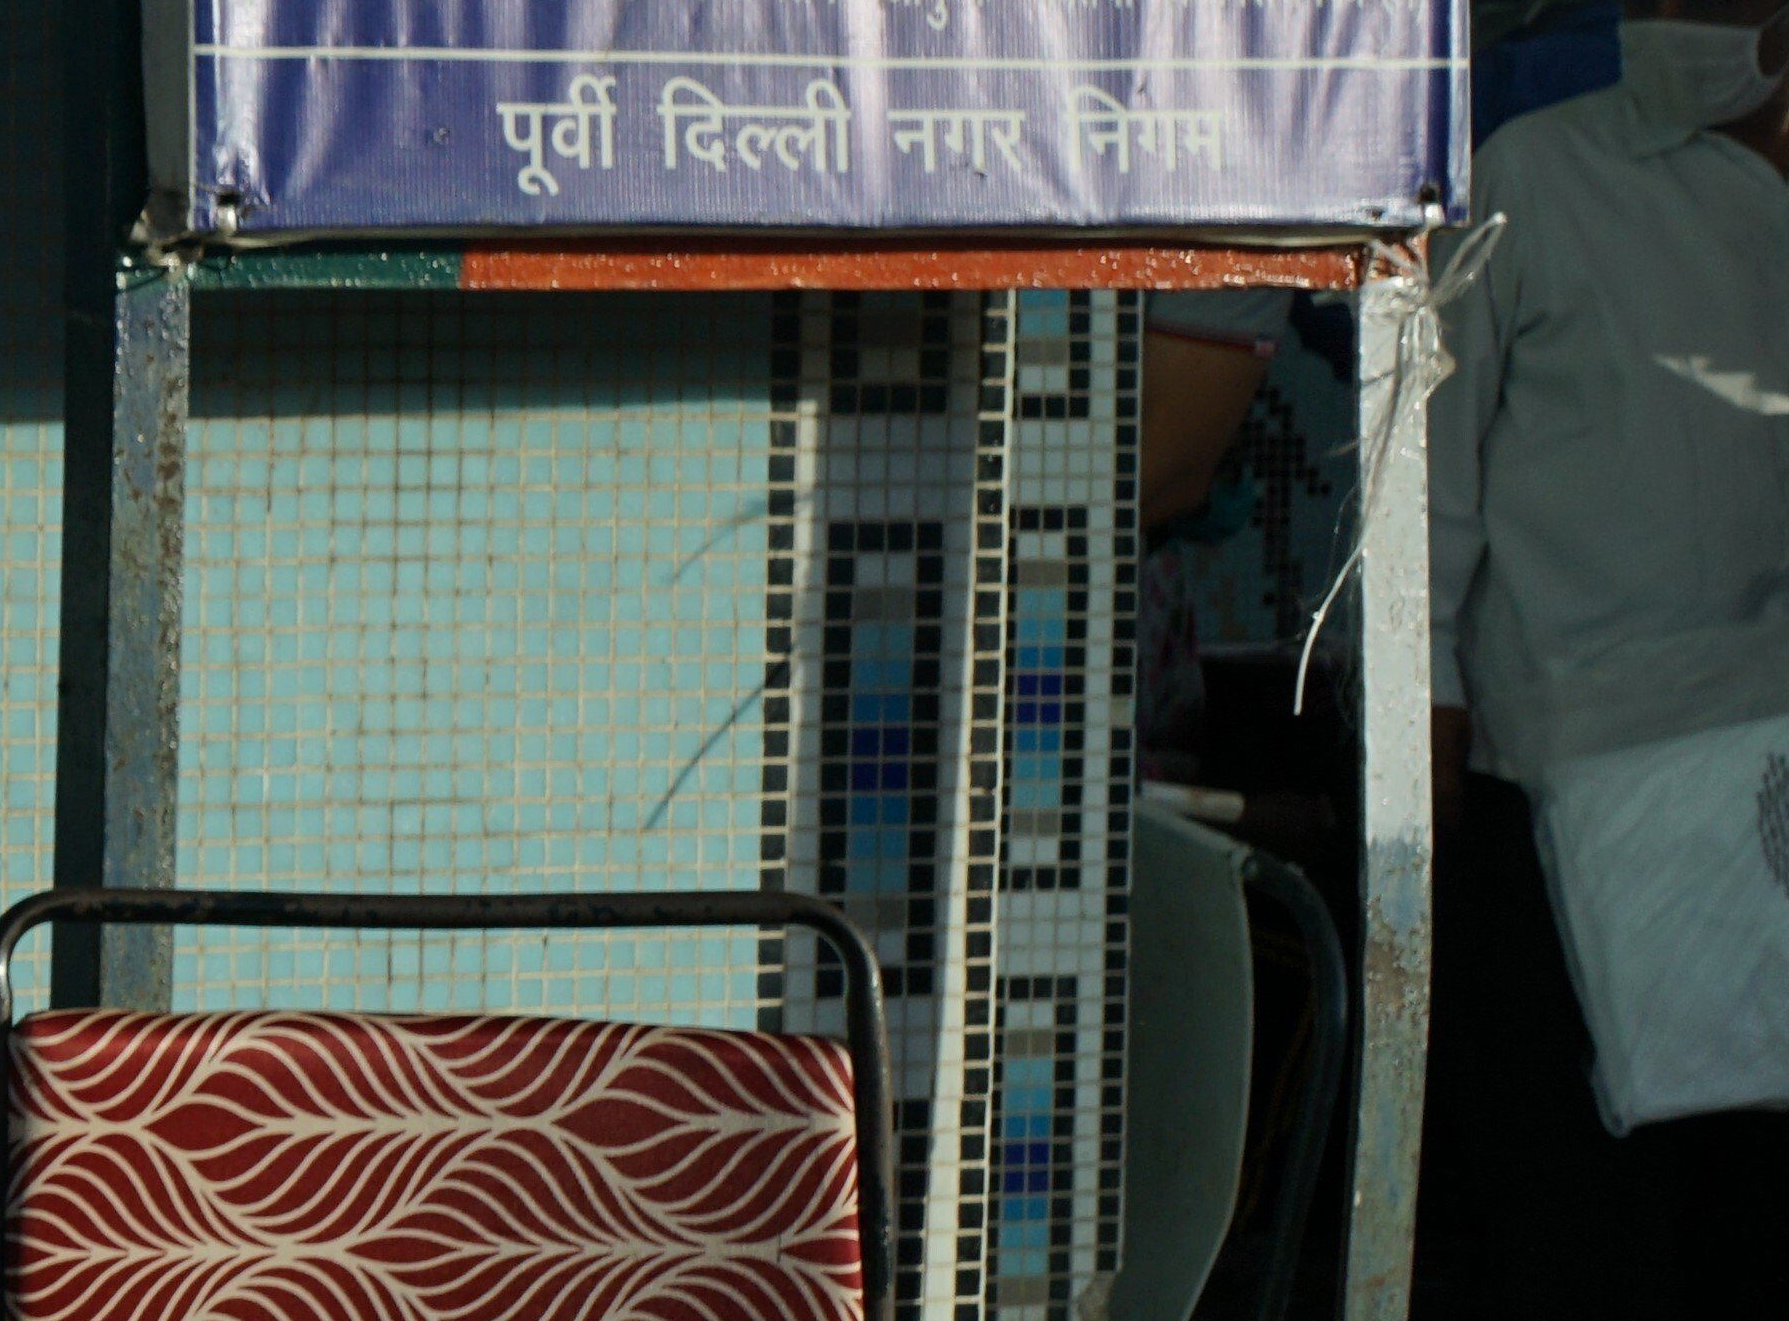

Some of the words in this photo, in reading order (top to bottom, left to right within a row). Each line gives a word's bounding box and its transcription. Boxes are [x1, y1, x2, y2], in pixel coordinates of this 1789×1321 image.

[496, 73, 617, 196] पूर्वी
[657, 76, 852, 173] दिल्ली
[889, 109, 1026, 174] नगर
[1063, 83, 1225, 174] निगम
